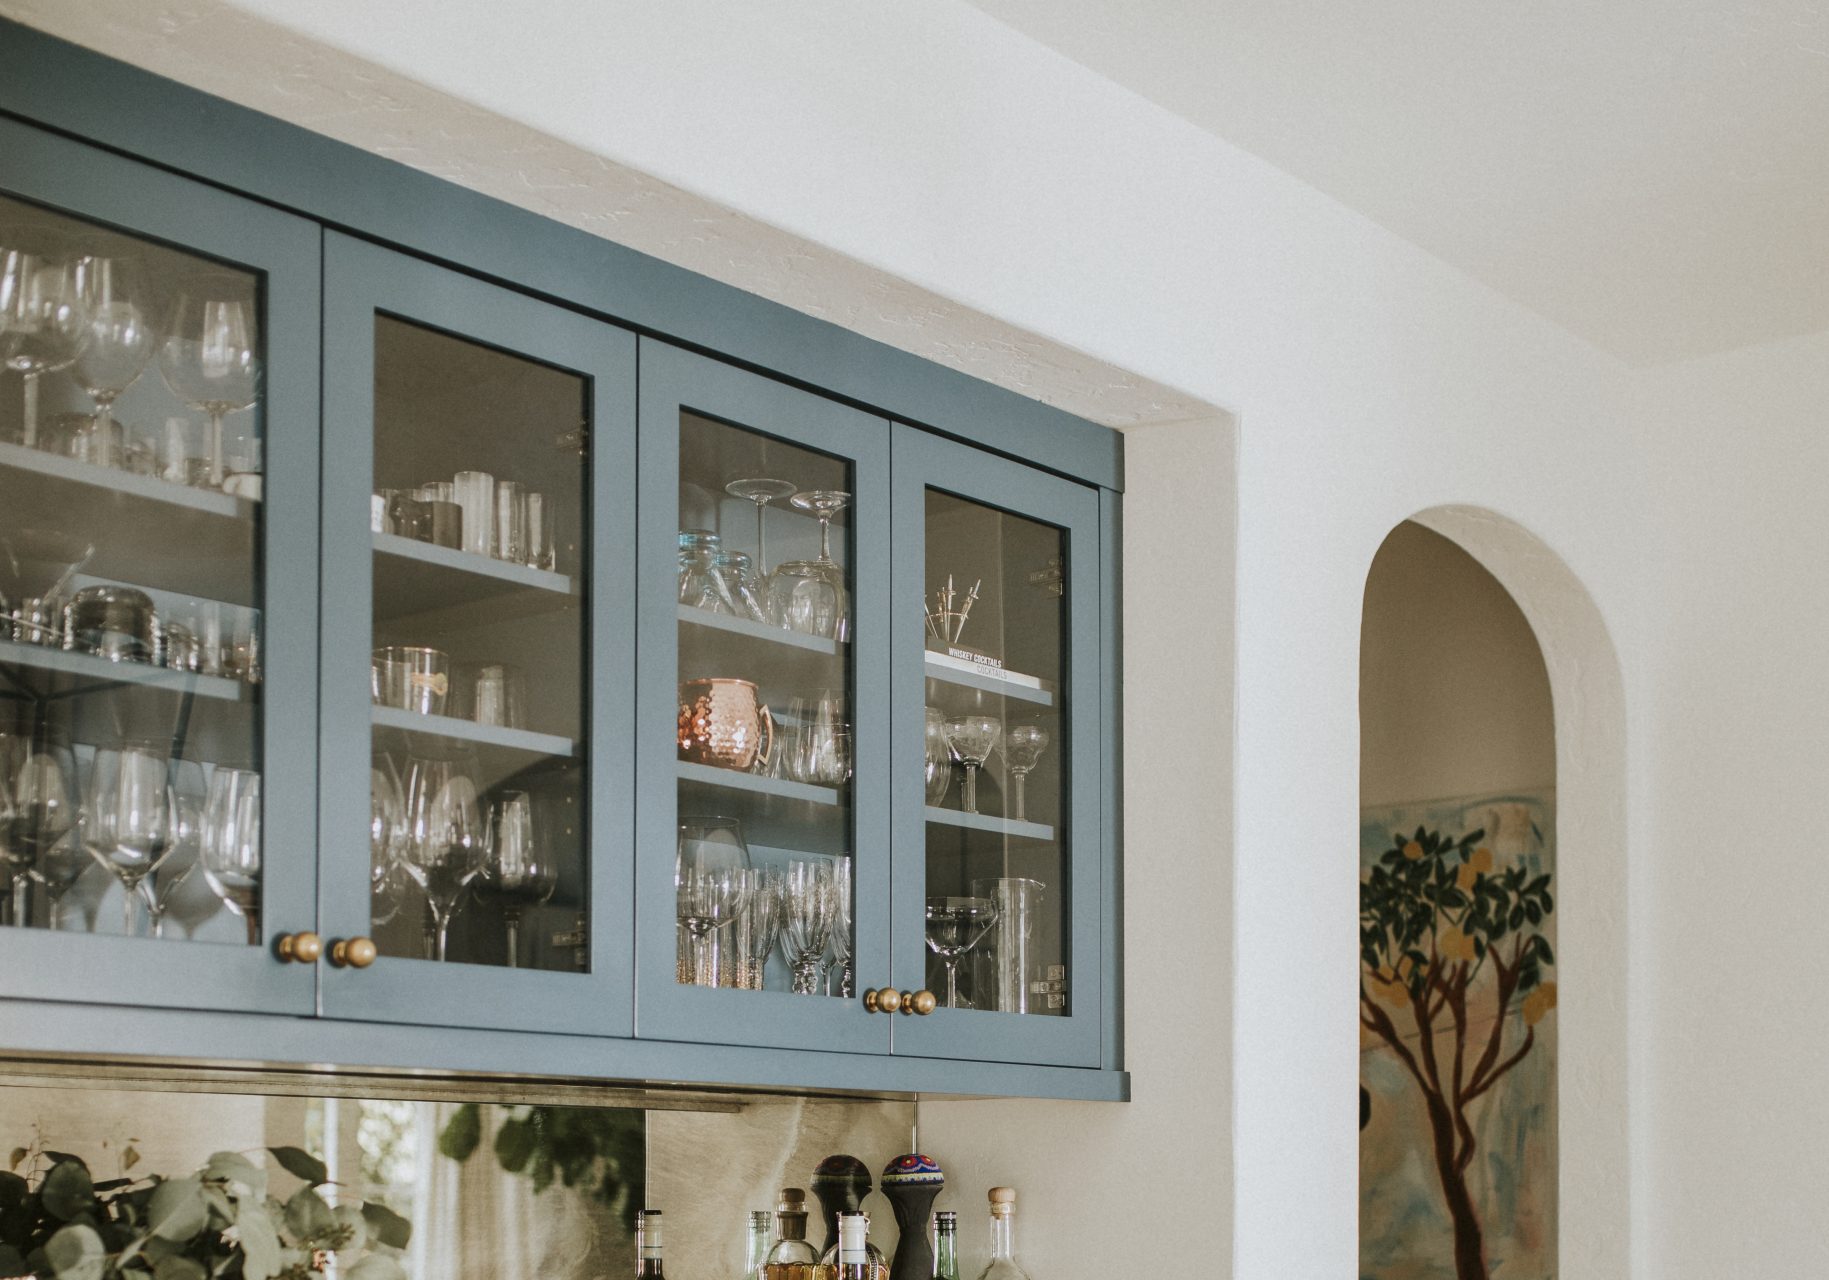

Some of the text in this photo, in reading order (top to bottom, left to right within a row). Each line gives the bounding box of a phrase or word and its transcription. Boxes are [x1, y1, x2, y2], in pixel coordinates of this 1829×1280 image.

[948, 647, 1002, 668] WHISKEY COCKTAILS
[976, 665, 1008, 680] COCKTAILS
